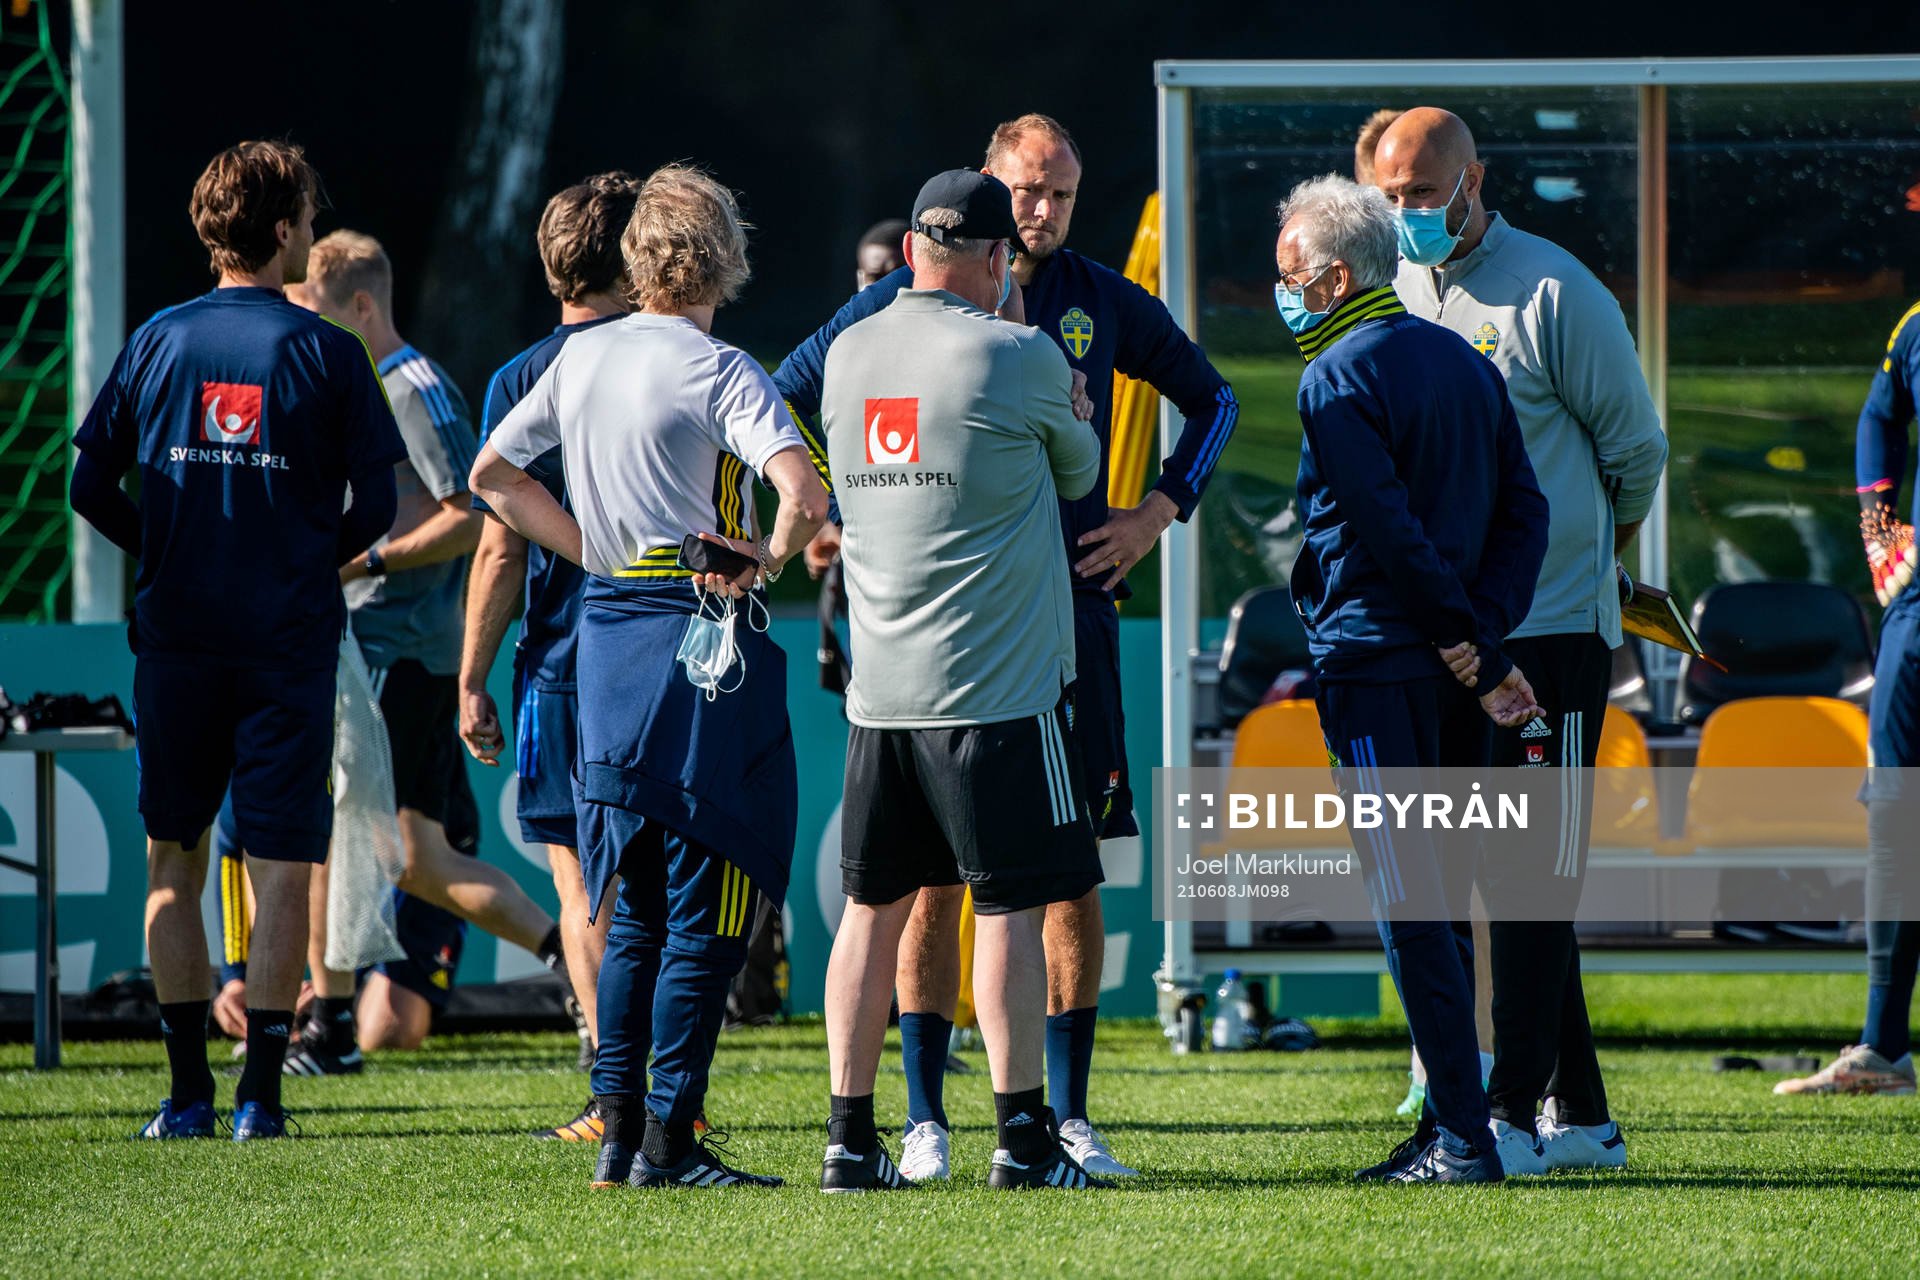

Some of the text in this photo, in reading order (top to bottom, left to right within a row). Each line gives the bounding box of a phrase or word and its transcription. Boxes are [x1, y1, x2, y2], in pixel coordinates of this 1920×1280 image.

[170, 446, 290, 470] SVENSKA SPEL
[845, 471, 958, 488] SVENSKA SPEL
[1520, 728, 1552, 738] adidas
